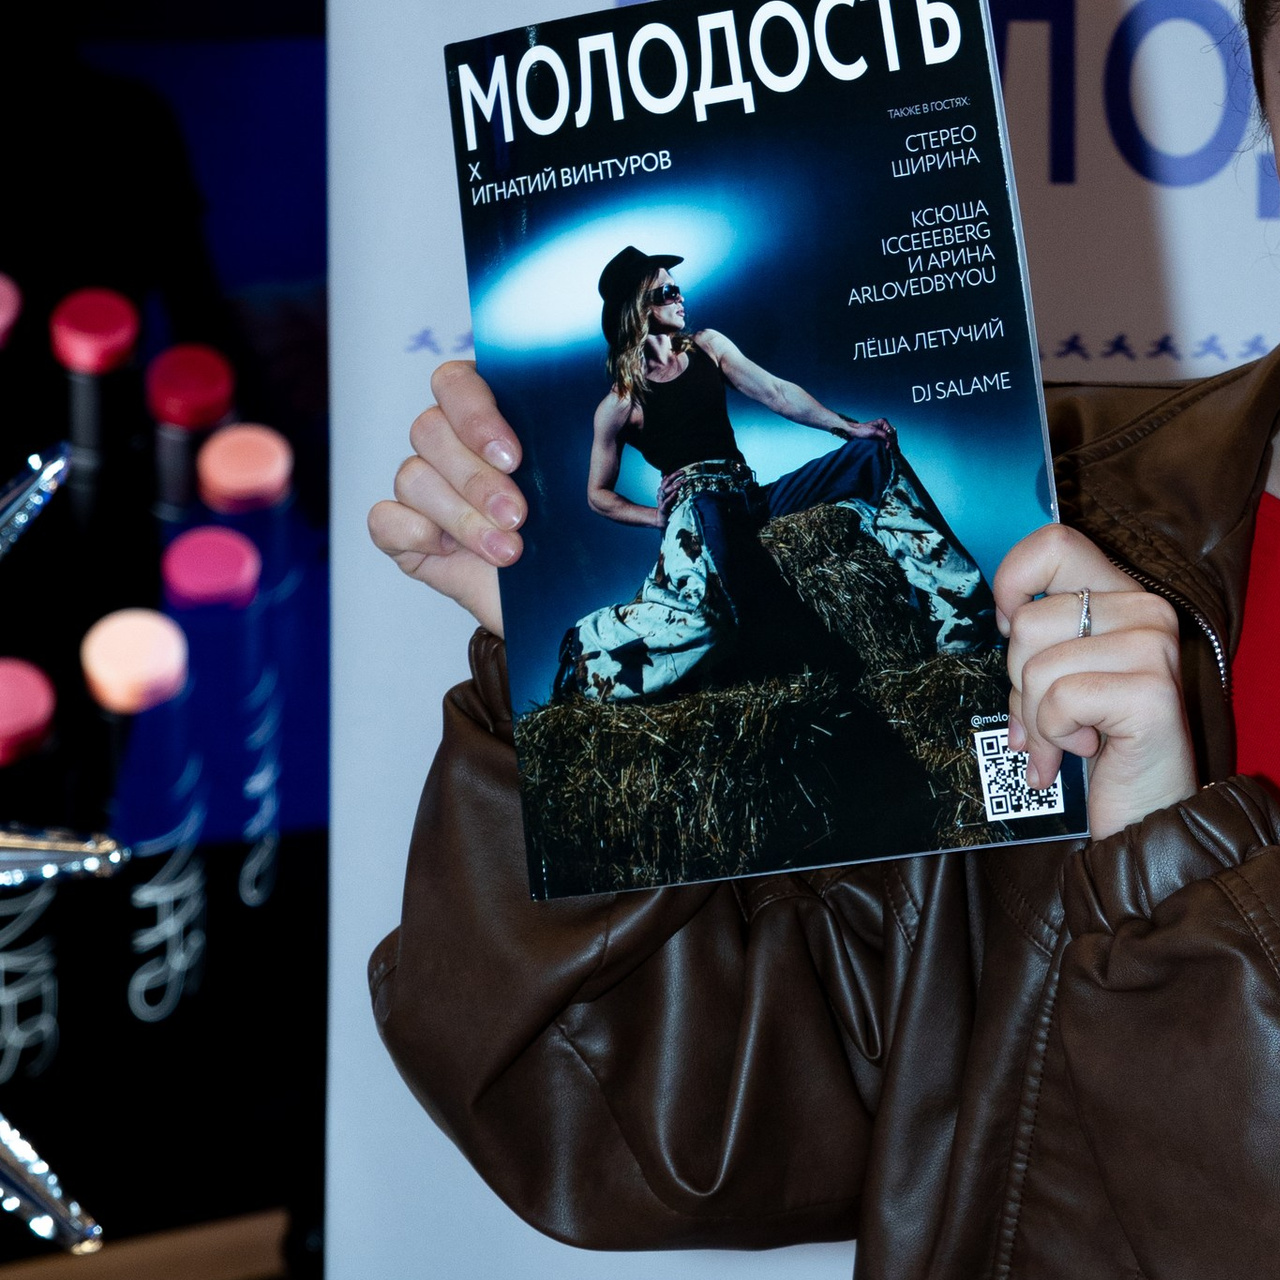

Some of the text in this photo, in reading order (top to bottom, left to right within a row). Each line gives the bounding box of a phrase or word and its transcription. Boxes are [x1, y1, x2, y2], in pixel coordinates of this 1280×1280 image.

[887, 96, 972, 120] ТАКЖЕ В ГОСТЯХ:
[905, 124, 977, 152] СТЕРЕО
[471, 150, 672, 206] ИГНАТИЙ ВИНТУРОВ
[891, 147, 981, 178] ШИРИНА
[911, 199, 989, 228] КСЮША
[881, 221, 991, 255] ICCEEEBERG
[908, 244, 996, 274] И АРИНА
[848, 265, 996, 306] ARLOVEDBYYOU
[853, 317, 1004, 361] ЛЁША ЛЕТУЧИЙ
[911, 371, 1012, 403] DJ SALAME
[971, 711, 1010, 728] @molo
